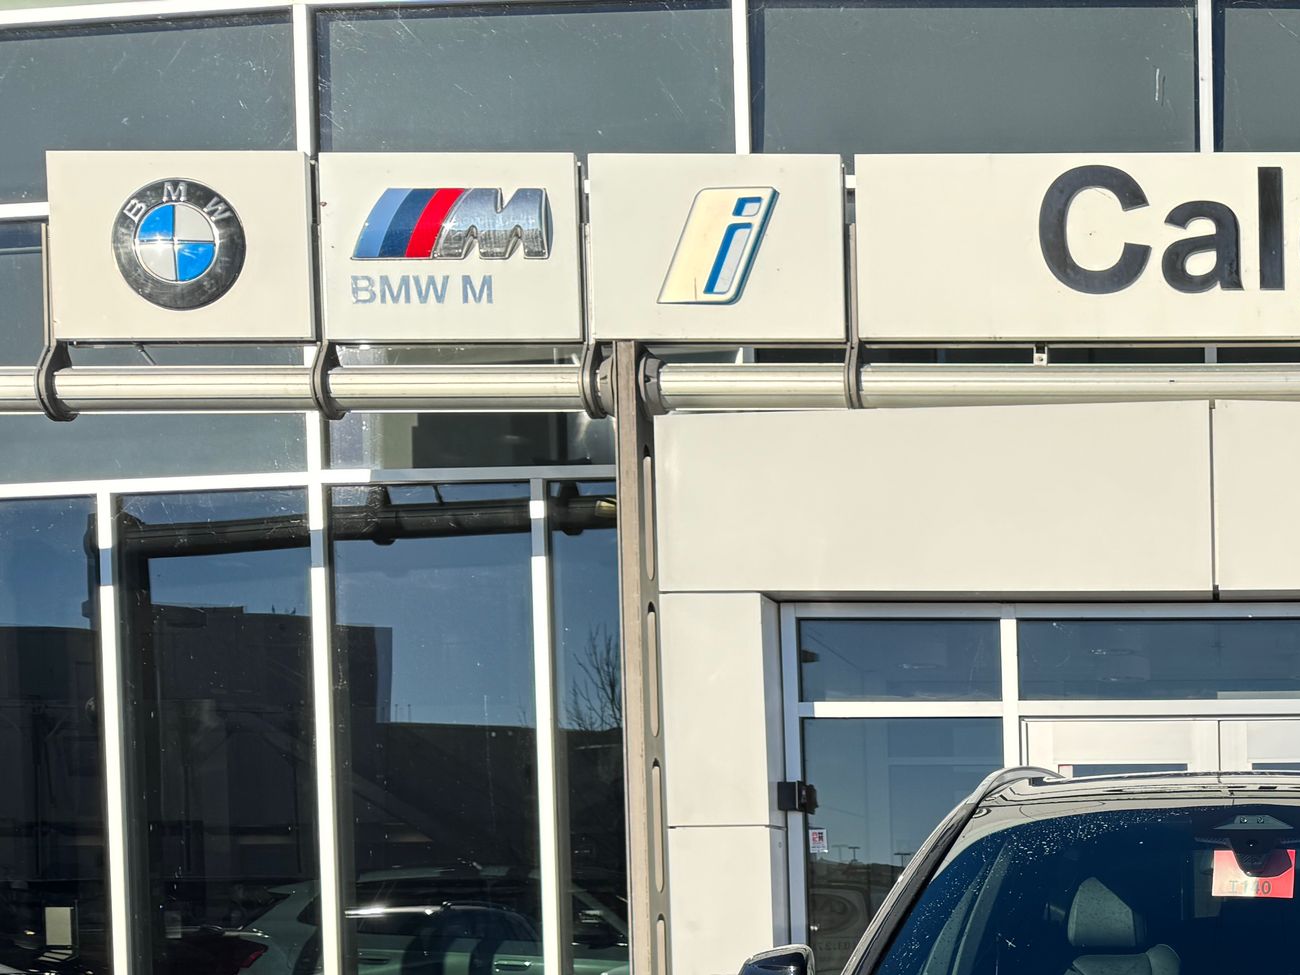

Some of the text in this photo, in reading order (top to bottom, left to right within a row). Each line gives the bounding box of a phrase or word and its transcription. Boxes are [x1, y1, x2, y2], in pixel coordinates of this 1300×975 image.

[123, 181, 234, 223] BMW
[351, 275, 494, 305] BMW M
